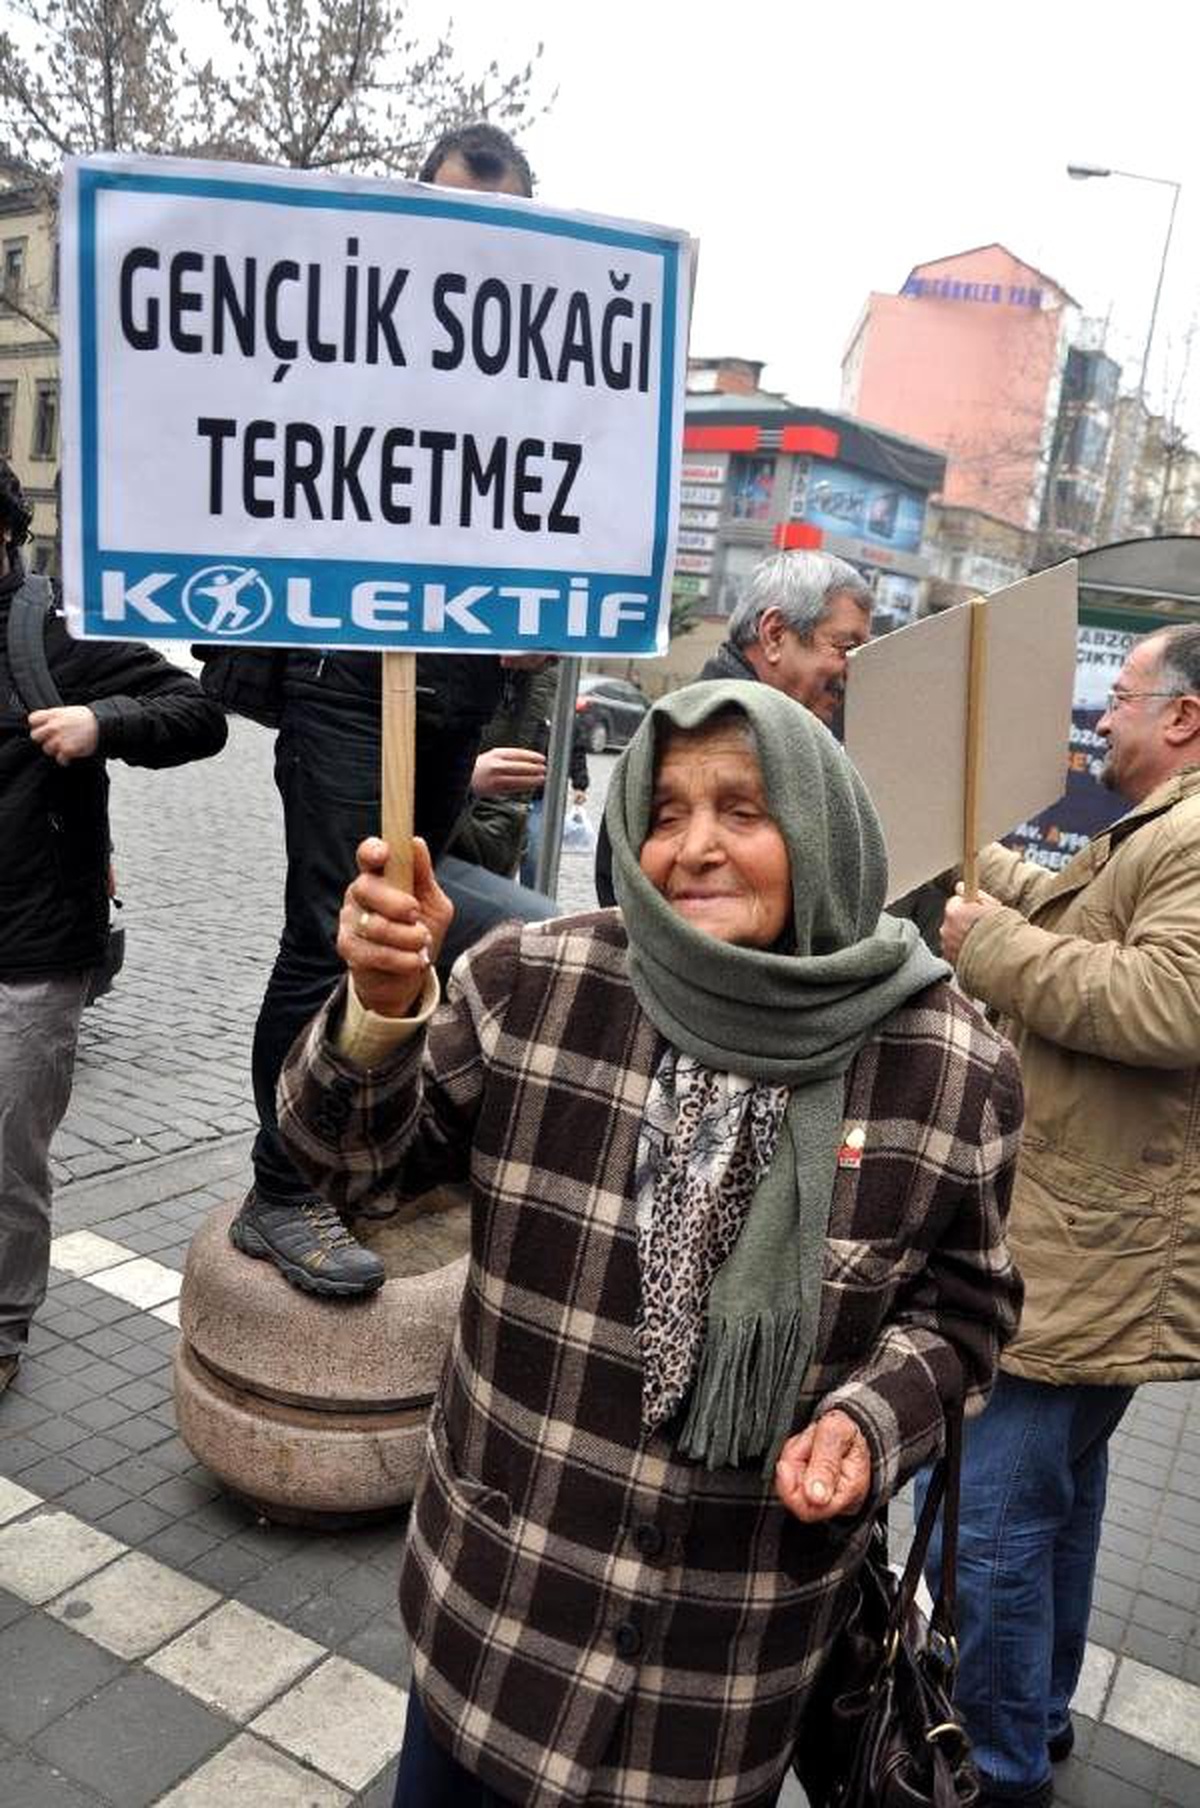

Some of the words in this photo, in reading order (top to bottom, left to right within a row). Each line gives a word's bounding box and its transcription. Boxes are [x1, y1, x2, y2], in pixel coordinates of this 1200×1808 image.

[120, 237, 409, 383] GENÇLİK
[432, 270, 652, 393] SOKAĞI
[197, 417, 583, 535] TERKETMEZ
